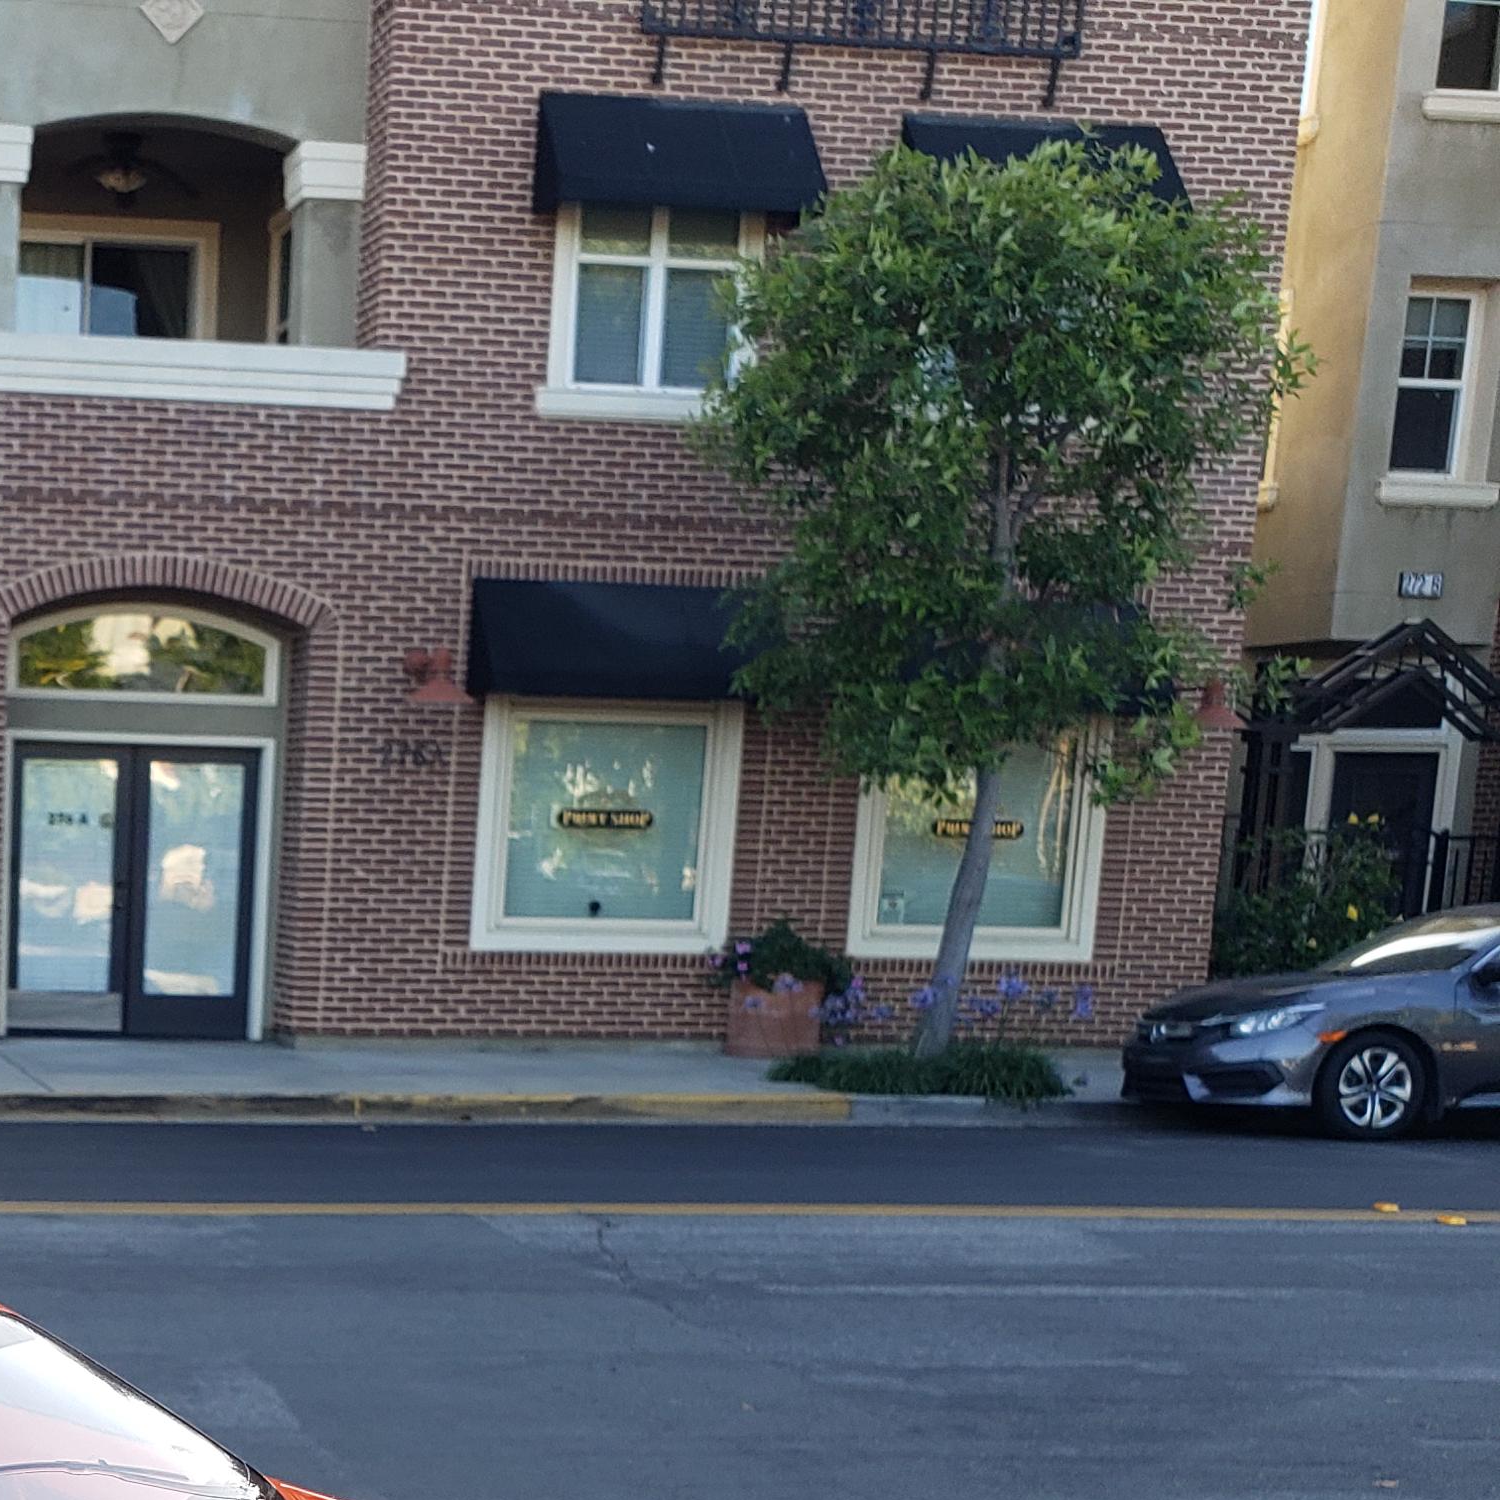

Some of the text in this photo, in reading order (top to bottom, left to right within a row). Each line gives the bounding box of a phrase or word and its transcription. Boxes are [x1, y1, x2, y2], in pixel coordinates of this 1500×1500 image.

[611, 811, 650, 827] SHOP
[937, 820, 1021, 837] PRIN HOP
